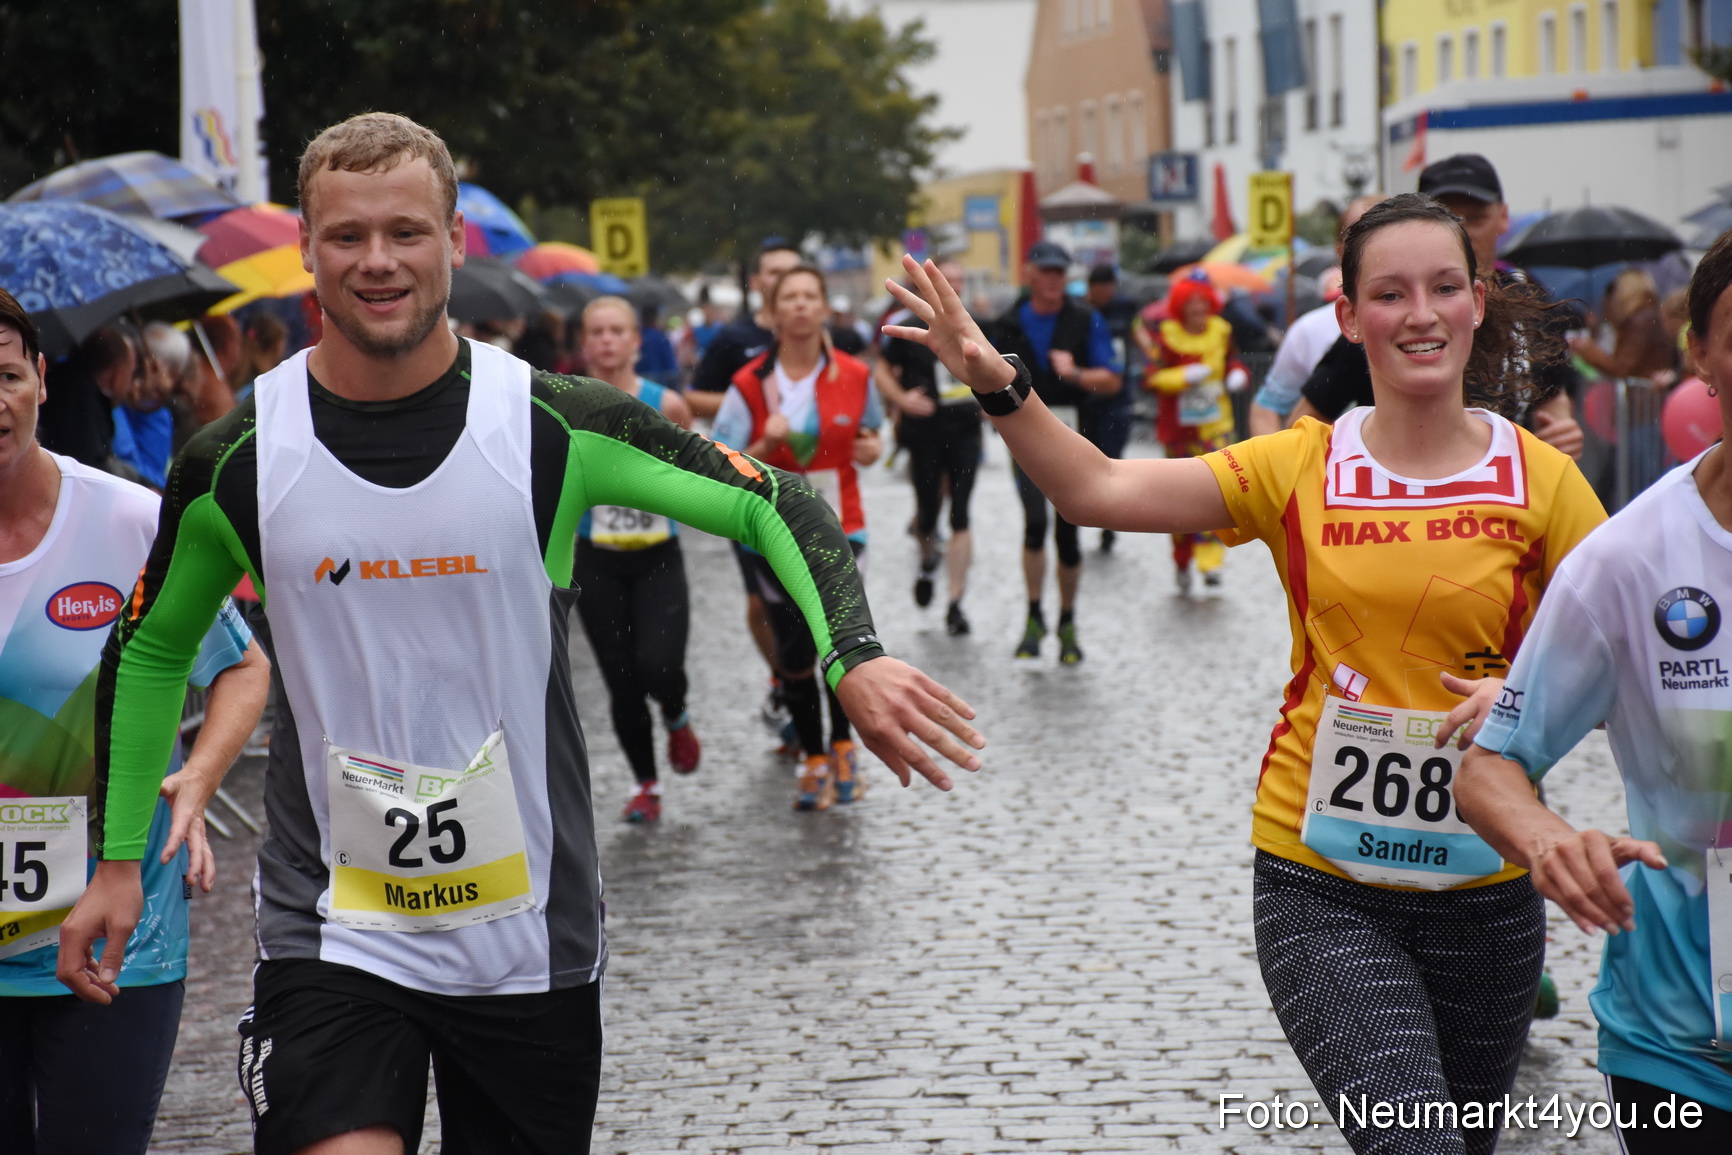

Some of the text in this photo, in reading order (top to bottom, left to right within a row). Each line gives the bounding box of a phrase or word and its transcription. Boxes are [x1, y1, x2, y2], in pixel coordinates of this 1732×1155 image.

[1260, 194, 1284, 232] D
[606, 223, 634, 260] D
[1321, 510, 1525, 546] MAX BÖGL
[359, 555, 488, 580] KLEBL
[57, 594, 116, 618] Hervis
[1659, 588, 1713, 611] BMW
[1659, 658, 1729, 678] PARTL
[1661, 676, 1730, 690] Neumarkt
[1333, 719, 1394, 738] NeuerMarkt
[342, 770, 404, 794] NeuerMarkt
[1329, 745, 1469, 824] 268
[1315, 800, 1323, 812] C
[384, 798, 466, 868] 25
[339, 852, 347, 864] C
[1357, 832, 1448, 866] Sandra
[384, 882, 479, 910] Markus
[251, 1071, 270, 1117] WHITE
